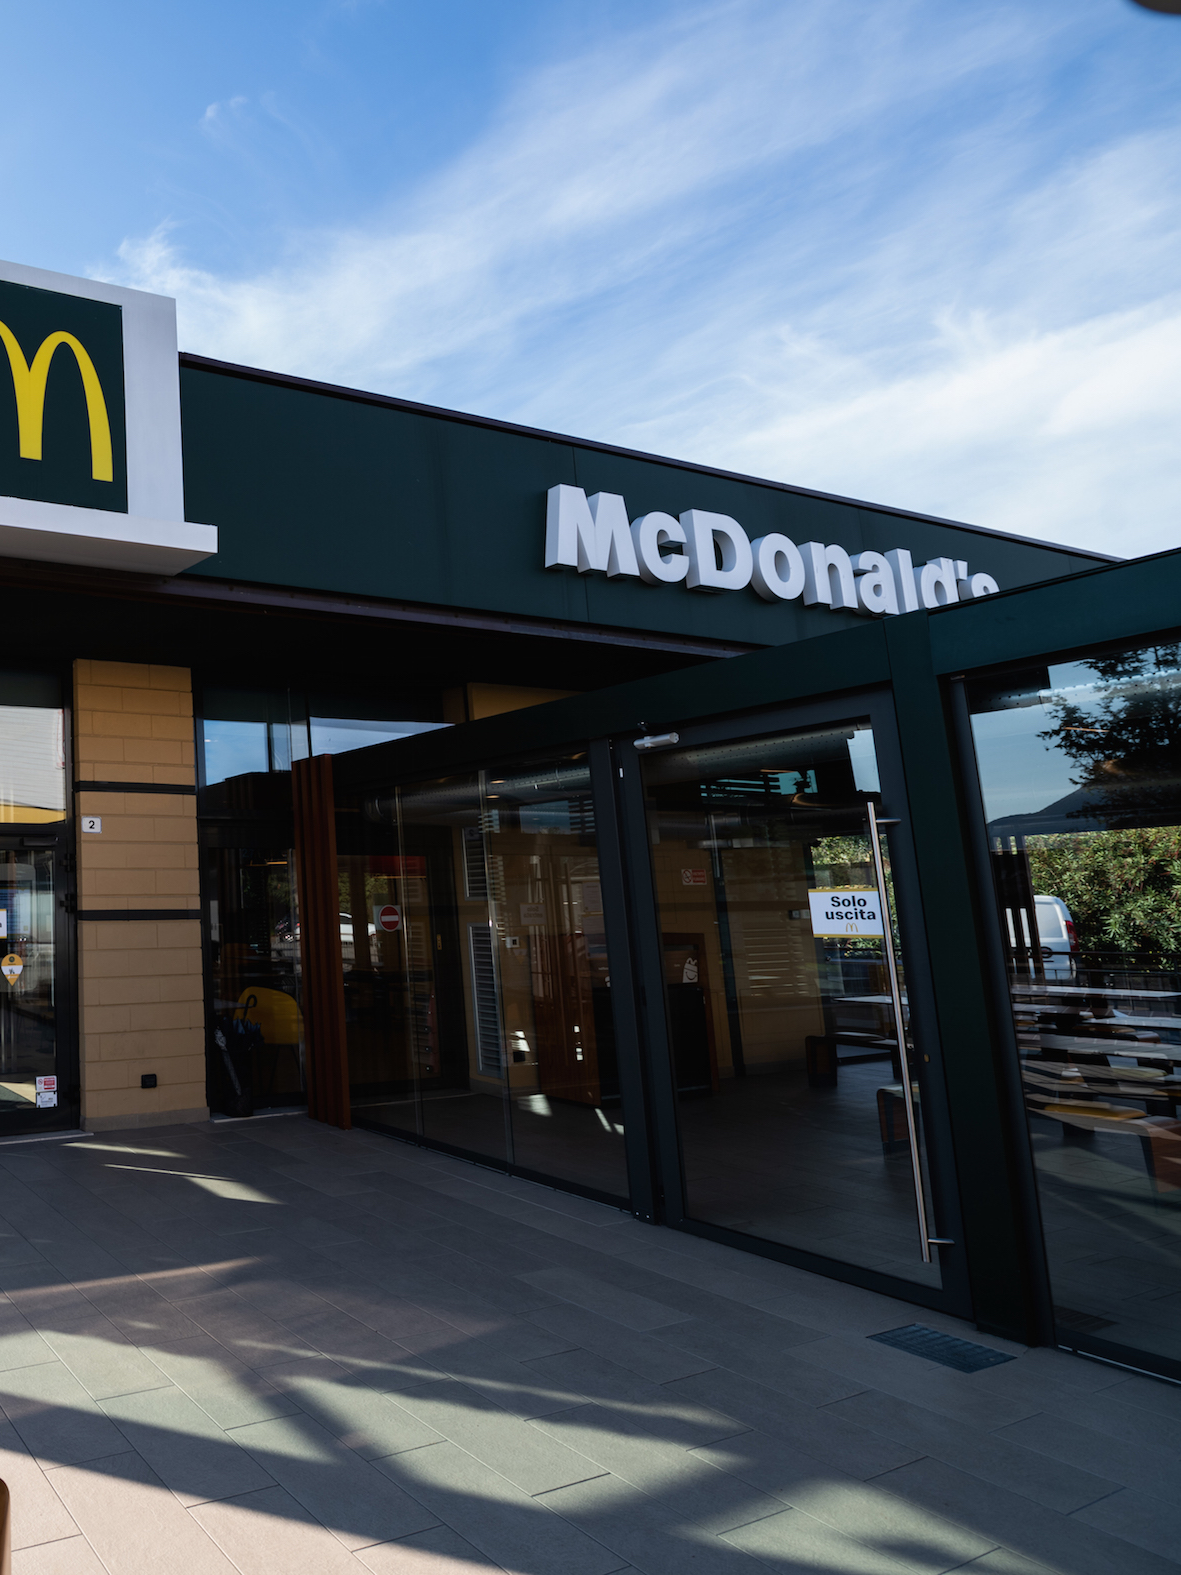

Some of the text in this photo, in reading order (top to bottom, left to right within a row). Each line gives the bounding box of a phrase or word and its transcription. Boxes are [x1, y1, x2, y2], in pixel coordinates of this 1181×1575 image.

[89, 820, 95, 829] 2
[830, 895, 867, 908] Solo
[825, 908, 876, 920] uscita
